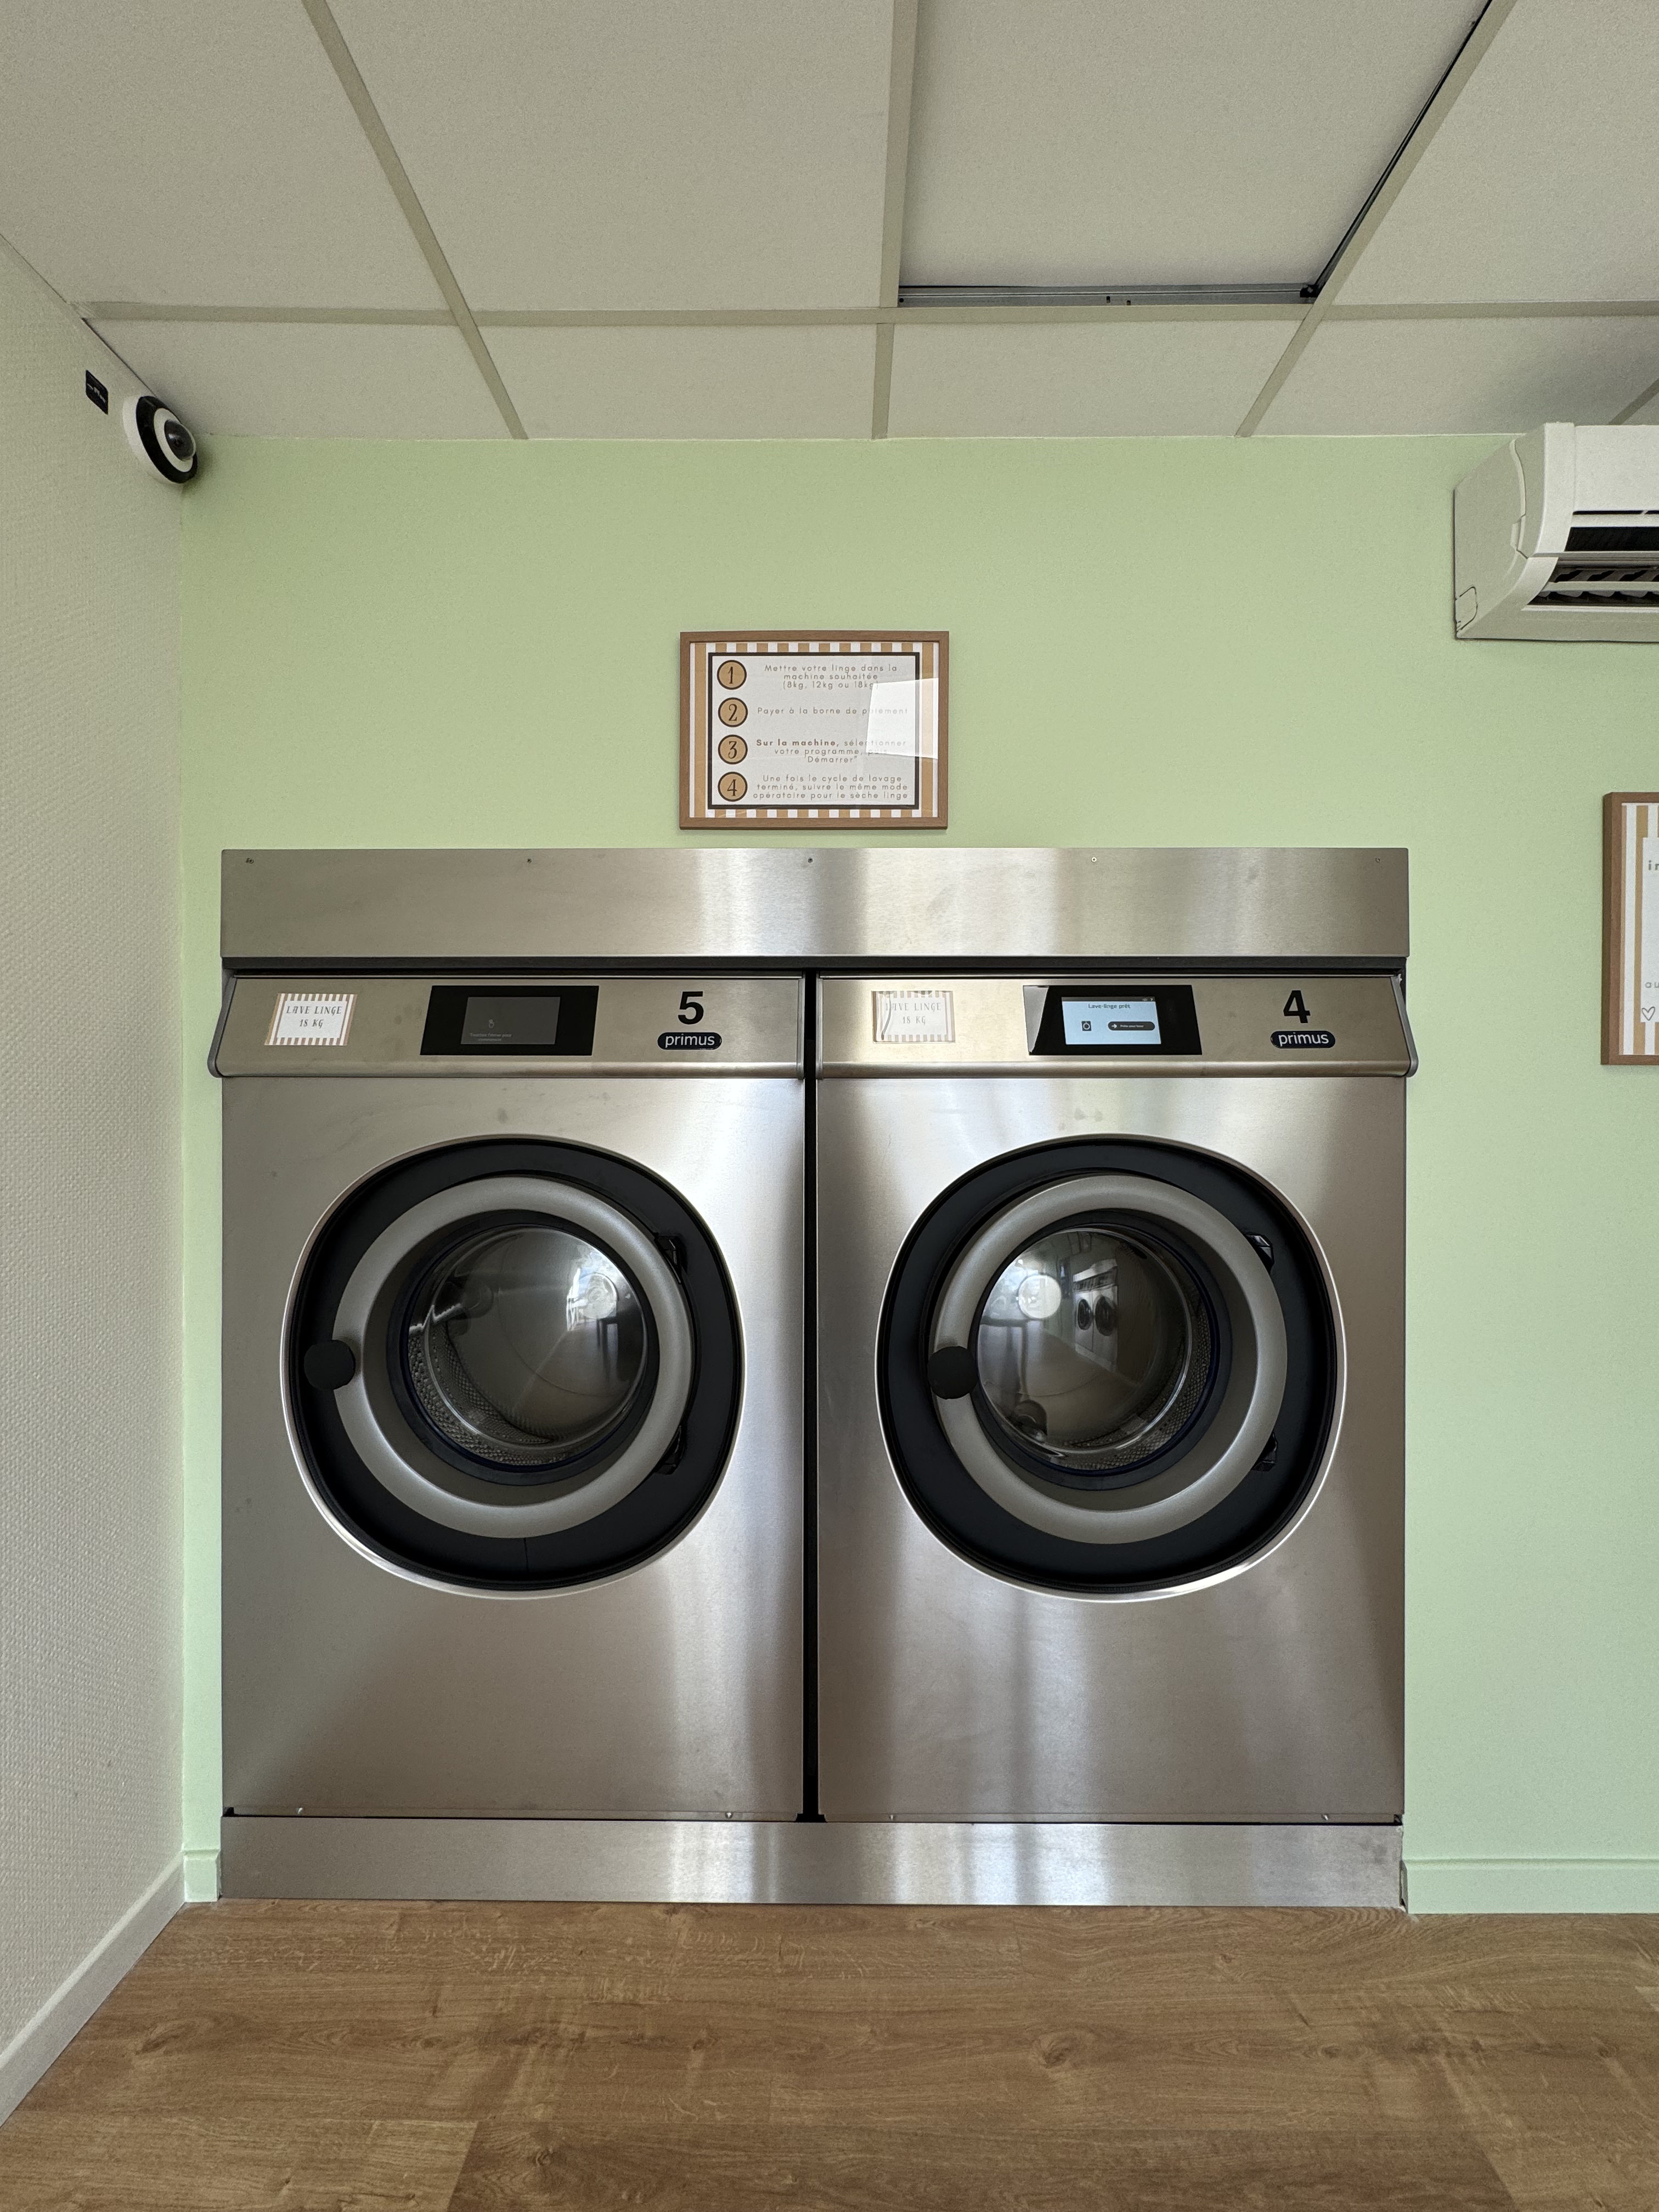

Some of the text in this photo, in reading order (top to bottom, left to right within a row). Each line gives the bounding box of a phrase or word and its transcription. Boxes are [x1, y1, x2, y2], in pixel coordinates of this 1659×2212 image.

[832, 664, 856, 673] linge
[728, 667, 733, 684] 1
[812, 681, 833, 690] 12kg
[728, 704, 737, 721] 2
[758, 707, 783, 716] Payer
[792, 738, 839, 747] machine,
[728, 741, 737, 759] 3
[804, 749, 862, 758] programme,
[822, 774, 848, 783] cycle
[868, 774, 902, 783] lavage
[727, 779, 737, 797] 4
[753, 792, 806, 800] opératoire
[883, 792, 907, 800] linge
[286, 1006, 342, 1015] LAVE LINGE
[678, 991, 704, 1025] 5
[914, 1002, 941, 1012] LINGE
[1283, 990, 1311, 1023] 4
[300, 1019, 324, 1028] 18 KG
[916, 1016, 926, 1025] KG
[665, 1033, 715, 1048] primus
[1278, 1032, 1329, 1047] primus
